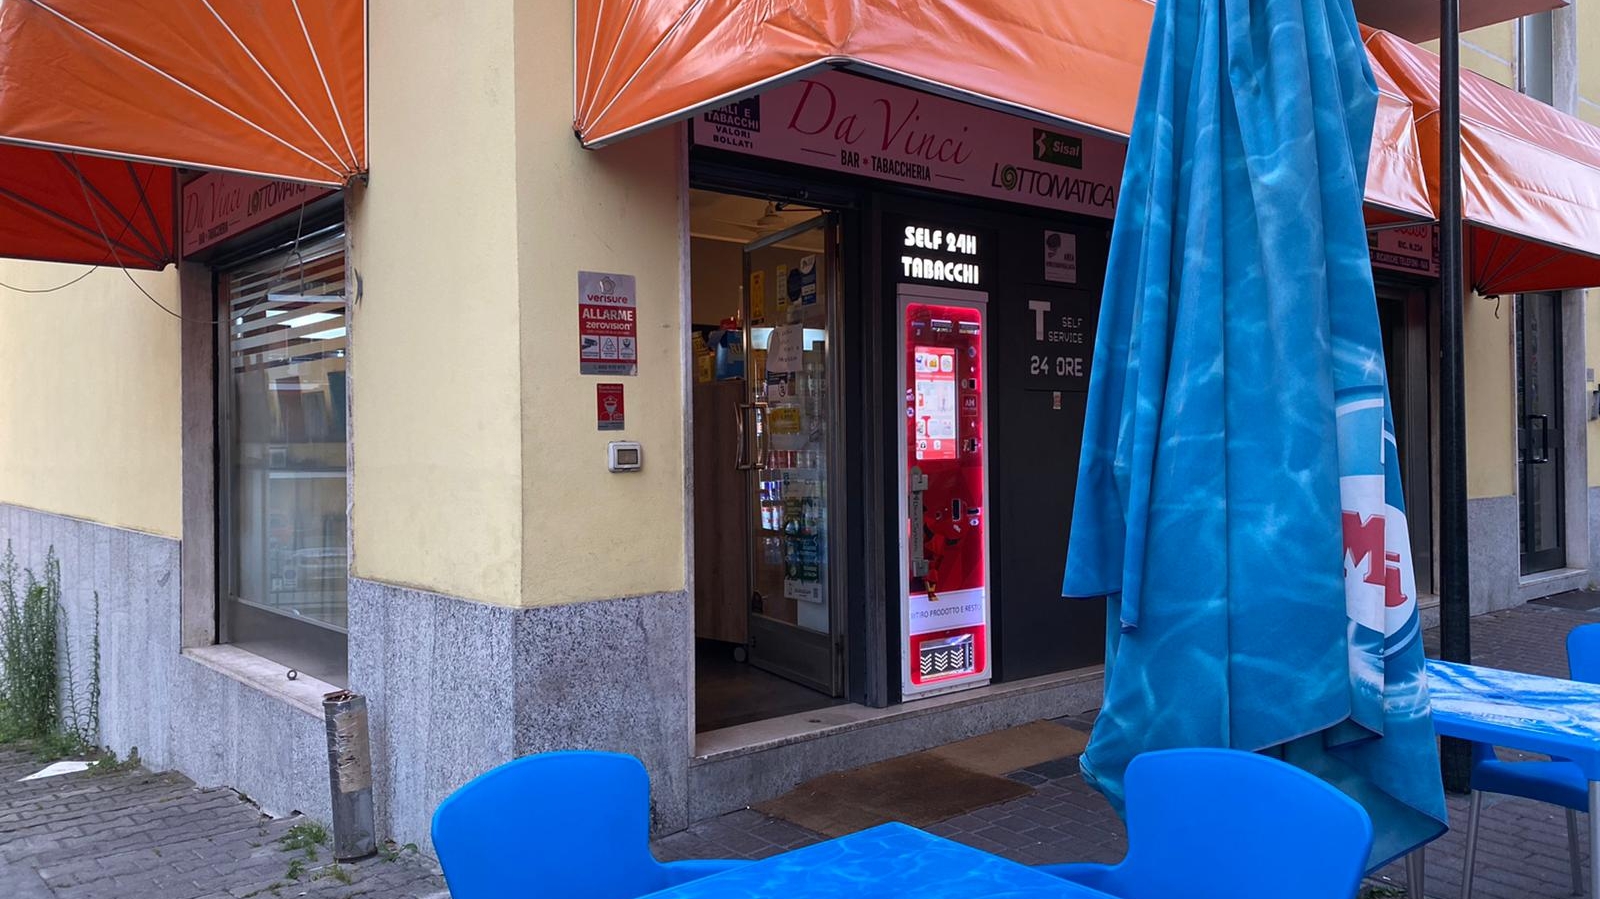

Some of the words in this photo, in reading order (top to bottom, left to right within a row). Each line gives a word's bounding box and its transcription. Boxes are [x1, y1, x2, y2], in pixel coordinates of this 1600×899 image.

[706, 111, 759, 130] TABACCHI
[788, 80, 865, 144] Da
[873, 98, 973, 165] Vinci
[715, 125, 751, 139] VALORI
[713, 134, 753, 149] BOLLATI
[1052, 140, 1081, 158] Sisal
[841, 150, 860, 169] BAR
[872, 155, 931, 181] TABACCHERIA
[991, 163, 1115, 209] LOTTOMATICA
[904, 225, 943, 250] SELF
[945, 232, 977, 255] 24H
[901, 255, 980, 285] TABACCHI
[587, 294, 628, 304] verisure
[582, 308, 634, 322] ALLARME
[1062, 316, 1083, 328] SELF
[1047, 331, 1084, 344] SERVICE
[1030, 355, 1049, 375] 24
[1056, 357, 1083, 377] ORE
